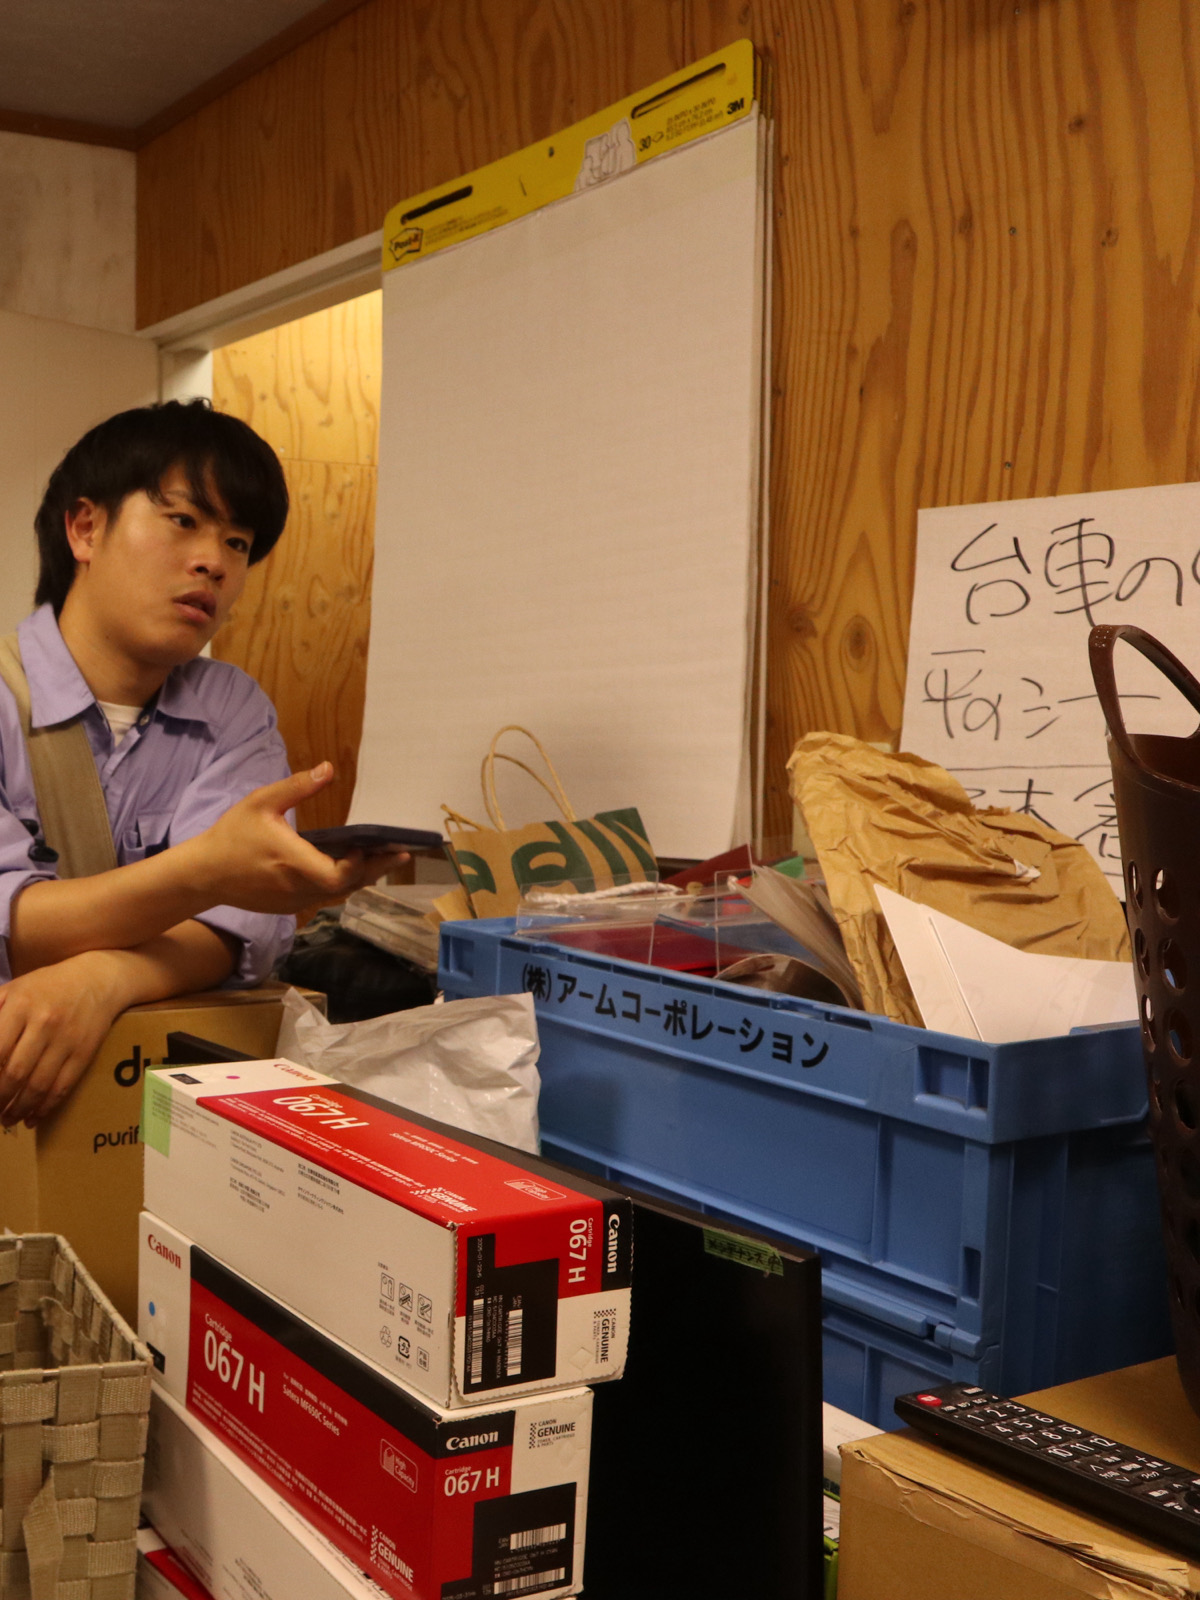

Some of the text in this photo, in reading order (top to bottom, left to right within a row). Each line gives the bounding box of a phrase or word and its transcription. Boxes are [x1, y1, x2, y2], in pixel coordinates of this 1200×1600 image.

[726, 97, 744, 115] 3M
[950, 517, 1200, 627] 台車の
[521, 962, 830, 1069] (株)アームコーポレーション
[273, 1063, 318, 1081] Canon
[272, 1096, 370, 1130] 067 H
[430, 1192, 478, 1212] GENUINE
[147, 1233, 182, 1270] Canon
[567, 1219, 588, 1284] 067 H
[606, 1213, 621, 1274] Canon
[204, 1312, 233, 1343] Cartridge
[600, 1318, 610, 1363] GENUINE
[203, 1329, 244, 1392] 067
[248, 1362, 266, 1414] H
[538, 1418, 557, 1427] CANON
[966, 1404, 1027, 1422] 1 2 3
[322, 1415, 341, 1437] Series
[537, 1422, 576, 1438] GENUINE
[995, 1415, 1055, 1433] 4 5 6
[445, 1430, 500, 1451] Canon
[1017, 1426, 1082, 1446] 7 8 9
[1047, 1437, 1117, 1458] 10 11 12
[444, 1465, 472, 1476] Cartridge
[443, 1466, 500, 1497] 067 H
[378, 1531, 397, 1551] CANON
[377, 1541, 415, 1584] GENUINE
